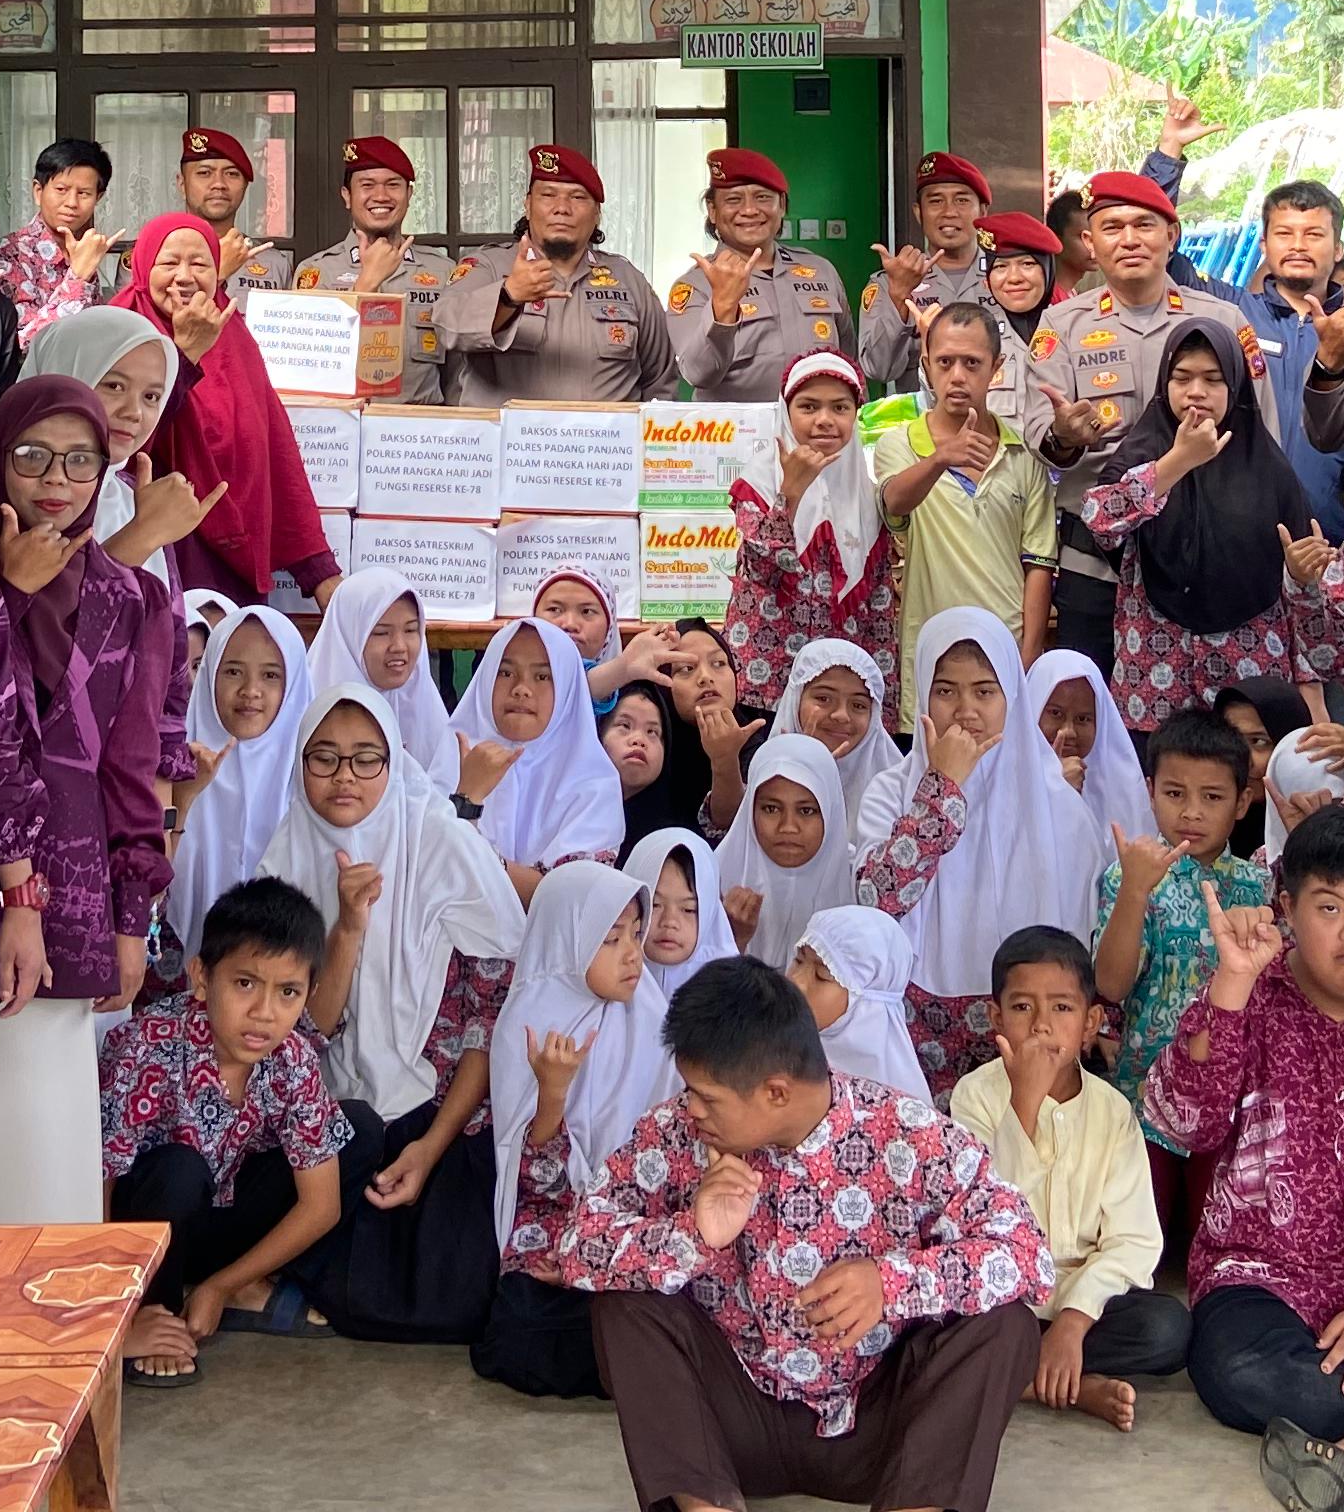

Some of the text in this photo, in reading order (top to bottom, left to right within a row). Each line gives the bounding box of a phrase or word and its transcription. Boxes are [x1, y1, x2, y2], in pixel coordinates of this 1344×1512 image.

[687, 31, 817, 59] KANTOR SEKOLAH
[793, 283, 829, 292] POLRI
[584, 290, 628, 302] POLRI
[263, 309, 293, 320] BAKSOS
[281, 325, 314, 337] PADANG
[315, 327, 351, 339] PANJANG
[280, 341, 312, 352] RANGKA
[313, 343, 332, 352] HARI
[333, 344, 350, 354] JADI
[288, 357, 319, 368] RESERSE
[320, 359, 341, 370] KE-78
[1078, 349, 1127, 367] ANDRE
[372, 368, 384, 382] 40
[520, 426, 620, 438] BAKSOS SATRESKRIM
[643, 419, 735, 443] IndoMili
[380, 433, 480, 446] BAKSOS SATRESKRIM
[303, 442, 349, 451] PANJANG
[506, 442, 633, 455] POLRES PADANG PANJANG
[303, 457, 349, 467] HARI JADI
[366, 448, 493, 463] POLRES PADANG PANJANG
[506, 458, 633, 471] DALAM RANGKA HARI JADI
[643, 458, 693, 469] Sardines
[311, 473, 338, 483] KE-78
[365, 464, 493, 479] DALAM RANGKA HARI JADI
[374, 481, 482, 494] FUNGSI RESERSE KE-78
[515, 475, 622, 487] FUNGSI RESERSE KE-78
[374, 538, 474, 551] BAKSOS SATRESKRIM
[516, 535, 617, 545] BAKSOS SATRESKRIM
[360, 553, 487, 568] POLRES PADANG PANJANG
[503, 550, 631, 561] POLRES PADANG PANJANG
[502, 566, 630, 577] DALAM JADI
[645, 560, 709, 574] Sardines
[439, 573, 463, 583] HARI
[464, 574, 486, 584] JADI
[448, 590, 475, 600] KE-78
